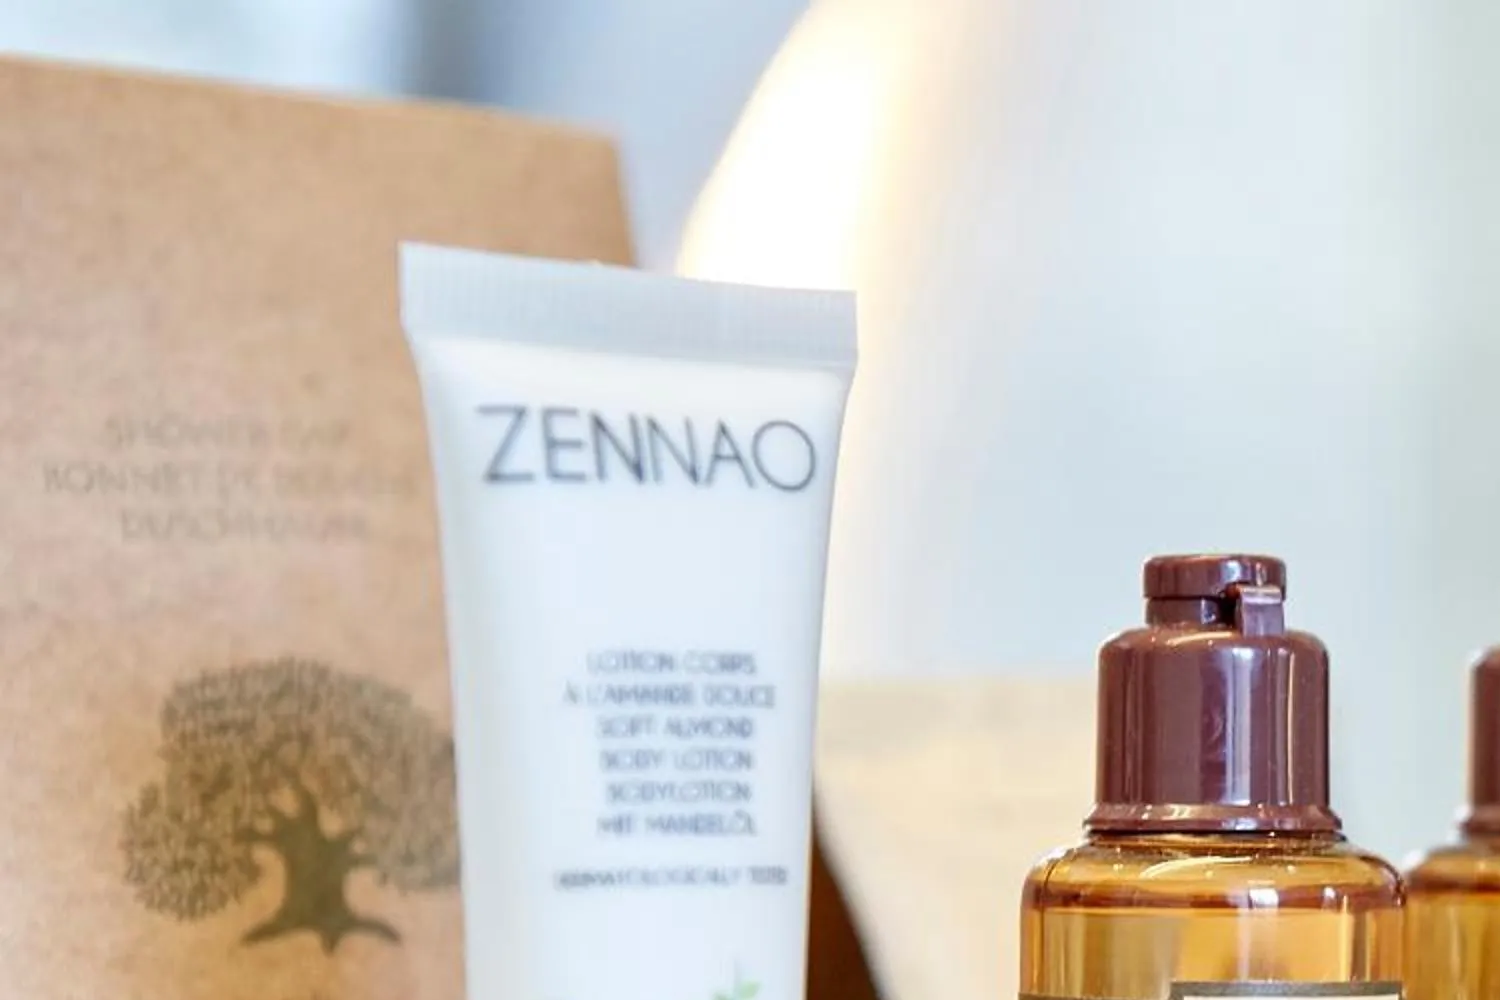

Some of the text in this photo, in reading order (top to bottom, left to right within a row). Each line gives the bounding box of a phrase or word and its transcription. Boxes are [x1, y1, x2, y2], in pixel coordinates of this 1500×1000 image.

[476, 403, 818, 493] ZENNAO
[587, 649, 759, 676] LOTION CORPS
[702, 684, 777, 709] DOUCE
[597, 714, 755, 739] SOFT ALMOND
[600, 749, 757, 774] BODY LOTION
[597, 814, 634, 837] MIT
